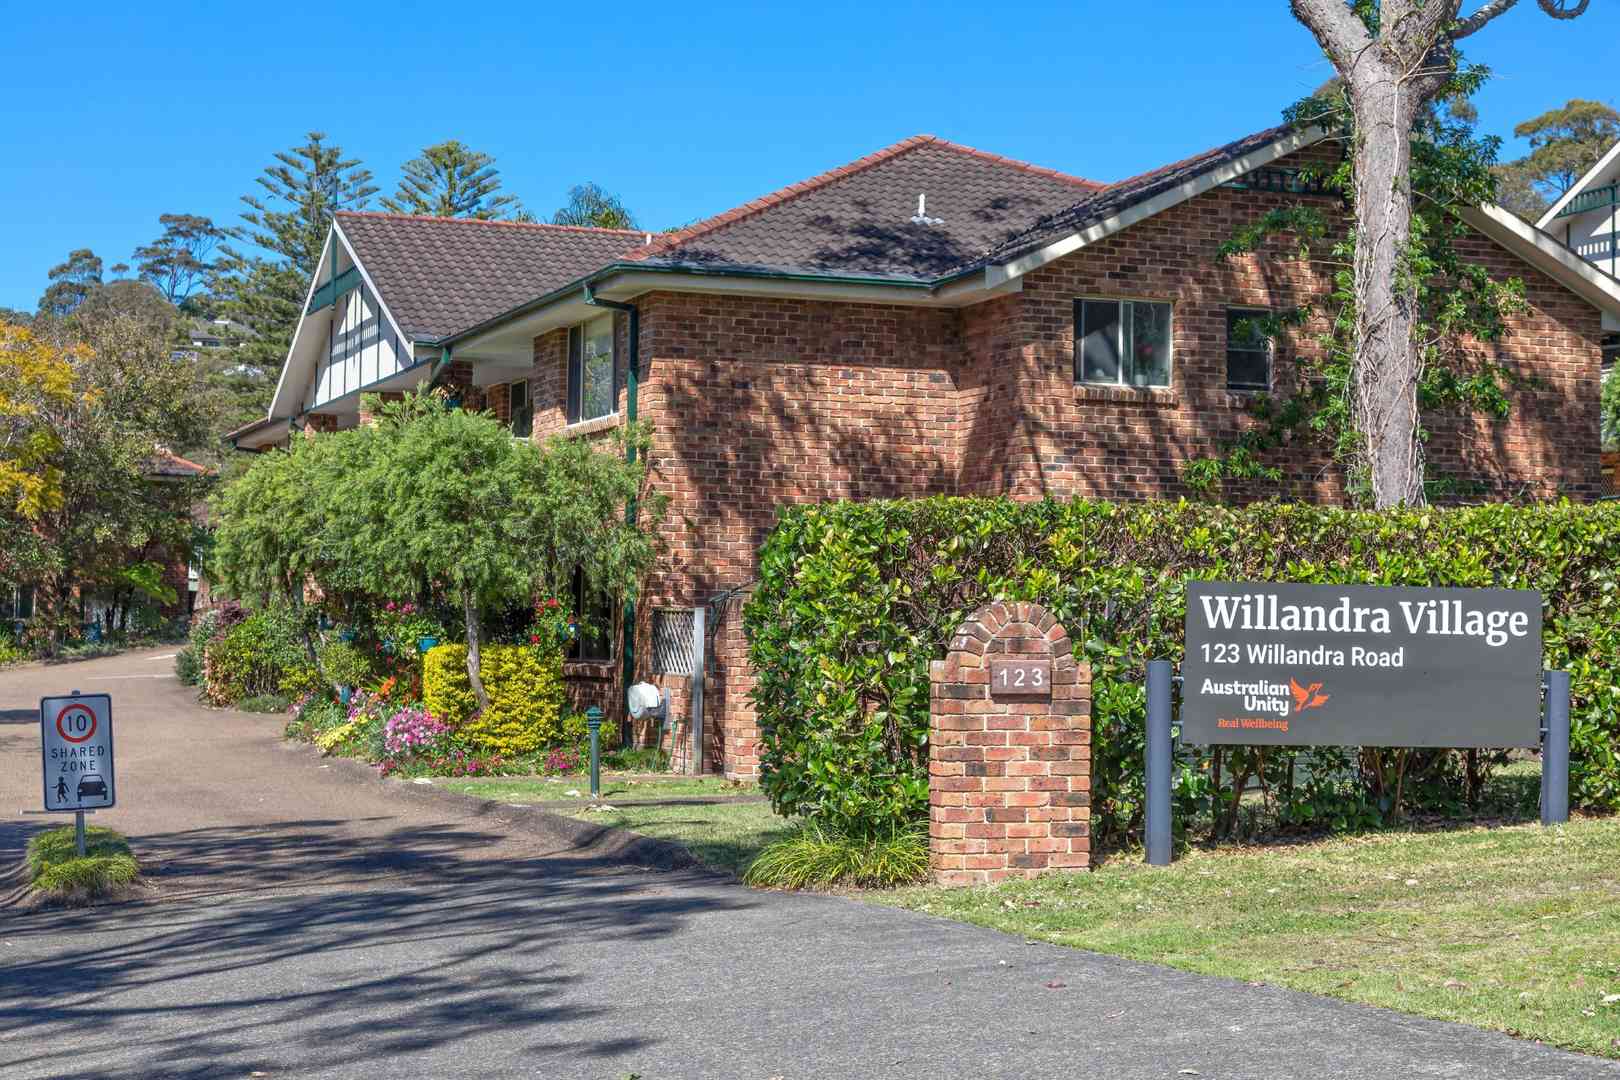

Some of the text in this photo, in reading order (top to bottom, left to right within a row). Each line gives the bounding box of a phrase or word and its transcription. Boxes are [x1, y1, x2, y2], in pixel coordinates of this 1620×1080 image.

[1200, 594, 1529, 647] Willandra Village
[1200, 643, 1404, 667] 123 Willandra Road
[1000, 668, 1043, 687] 123
[1200, 678, 1290, 697] Australian
[1244, 695, 1290, 716] Unity
[68, 714, 87, 732] 10
[1217, 718, 1289, 732] Real Wellbeing
[51, 745, 105, 759] SHARED
[61, 760, 96, 773] ZONE
